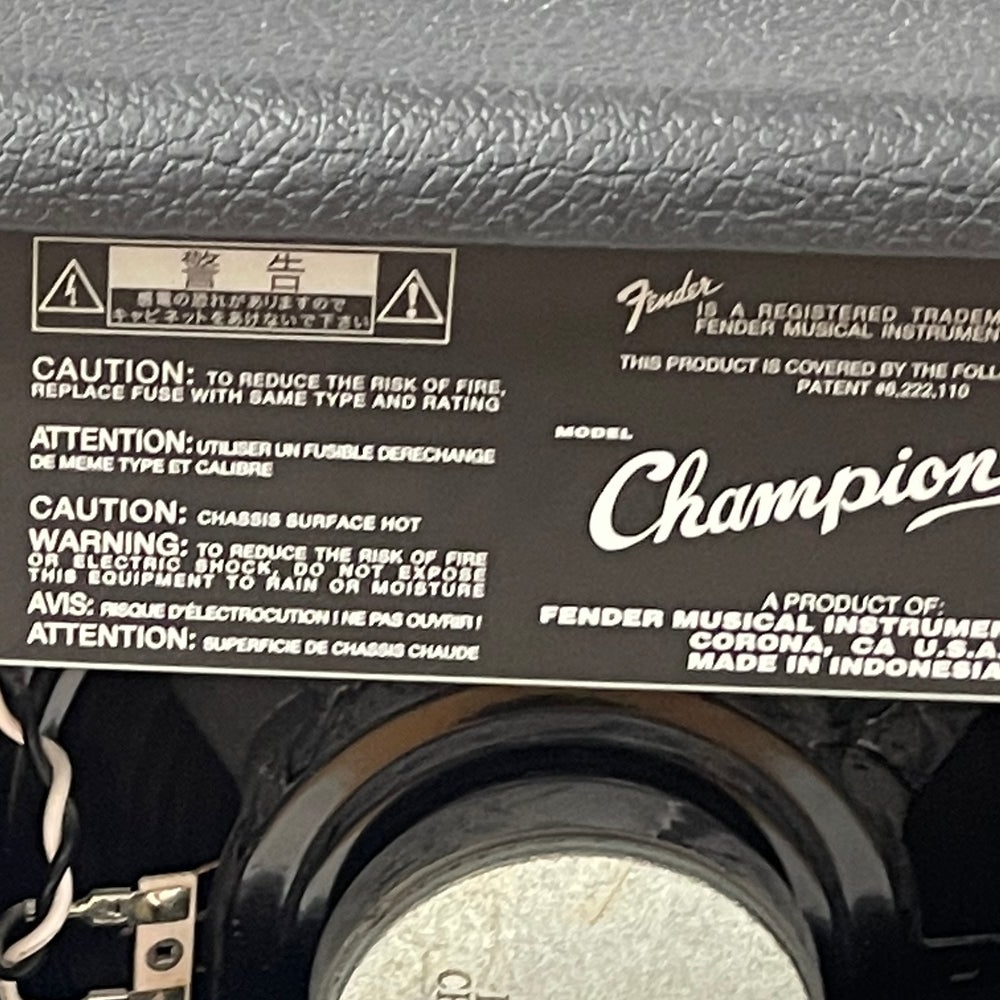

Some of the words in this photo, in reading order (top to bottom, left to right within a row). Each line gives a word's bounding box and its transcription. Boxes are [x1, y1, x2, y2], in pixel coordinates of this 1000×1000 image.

[617, 269, 726, 335] Fender
[696, 300, 718, 317] IS
[729, 301, 746, 318] A
[758, 302, 898, 323] REGISTERED
[694, 318, 776, 336] FENDER
[783, 320, 874, 339] MUSICAL
[32, 355, 195, 386] CAUTION:
[206, 370, 233, 386] TO
[239, 371, 320, 390] REDUCE
[326, 373, 367, 391] THE
[370, 375, 417, 392] RISK
[422, 377, 451, 393] OF
[456, 378, 506, 397] FIRE,
[620, 353, 662, 371] THIS
[665, 355, 760, 374] PRODUCT
[762, 357, 782, 375] IS
[784, 358, 876, 377] COVERED
[880, 361, 908, 378] BY
[911, 361, 950, 379] THE
[31, 382, 126, 400] REPLACE
[131, 385, 184, 402] FUSE
[191, 387, 243, 404] WITH
[249, 388, 308, 407] SAME
[313, 391, 367, 409] TYPE
[371, 393, 417, 411] AND
[422, 394, 500, 413] RATING
[796, 378, 872, 397] PATENT
[30, 425, 194, 455] ATTENTION:
[195, 439, 272, 457] UTILISER
[275, 441, 302, 459] UN
[303, 442, 375, 462] FUSIBLE
[554, 425, 634, 441] MODEL
[30, 453, 57, 470] DE
[58, 454, 115, 472] MEME
[118, 456, 165, 474] TYPE
[168, 458, 193, 475] ET
[195, 458, 274, 478] CALIBRE
[29, 494, 188, 525] CAUTION:
[197, 509, 281, 528] CHASSIS
[285, 512, 377, 532] SURFACE
[380, 515, 422, 533] HOT
[589, 446, 1000, 552] Champion
[28, 527, 189, 558] WARNING:
[196, 542, 224, 558] TO
[229, 543, 307, 562] REDUCE
[313, 546, 353, 563] THE
[358, 547, 404, 565] RISK
[409, 549, 438, 566] OF
[445, 550, 489, 567] FIRE
[27, 552, 60, 568] OR
[72, 553, 182, 573] ELECTRIC
[194, 557, 280, 577] SHOCK,
[293, 561, 326, 578] DO
[338, 563, 385, 579] NOT
[398, 564, 487, 583] EXPOSE
[27, 567, 78, 584] THIS
[88, 569, 216, 589] EQUIPMENT
[225, 575, 256, 590] TO
[265, 576, 319, 593] RAIN
[328, 578, 361, 595] OR
[371, 579, 486, 599] MOISTURE
[27, 589, 95, 617] AVIS:
[100, 600, 167, 620] RISQUE
[341, 610, 367, 627] NE
[368, 611, 404, 628] PAS
[539, 604, 665, 629] FENDER
[671, 608, 816, 633] MUSICAL
[760, 591, 779, 611] A
[783, 592, 902, 616] PRODUCT
[904, 595, 946, 617] OF:
[26, 620, 197, 651] ATTENTION:
[202, 635, 302, 655] SUPERFICIE
[304, 639, 329, 656] DE
[331, 640, 405, 659] CHASSIS
[407, 643, 480, 661] CHAUDE
[688, 630, 833, 658] CORONA,
[851, 636, 896, 657] CA
[686, 651, 779, 673] MADE
[785, 654, 822, 675] IN
[828, 656, 1000, 681] INDONESIA
